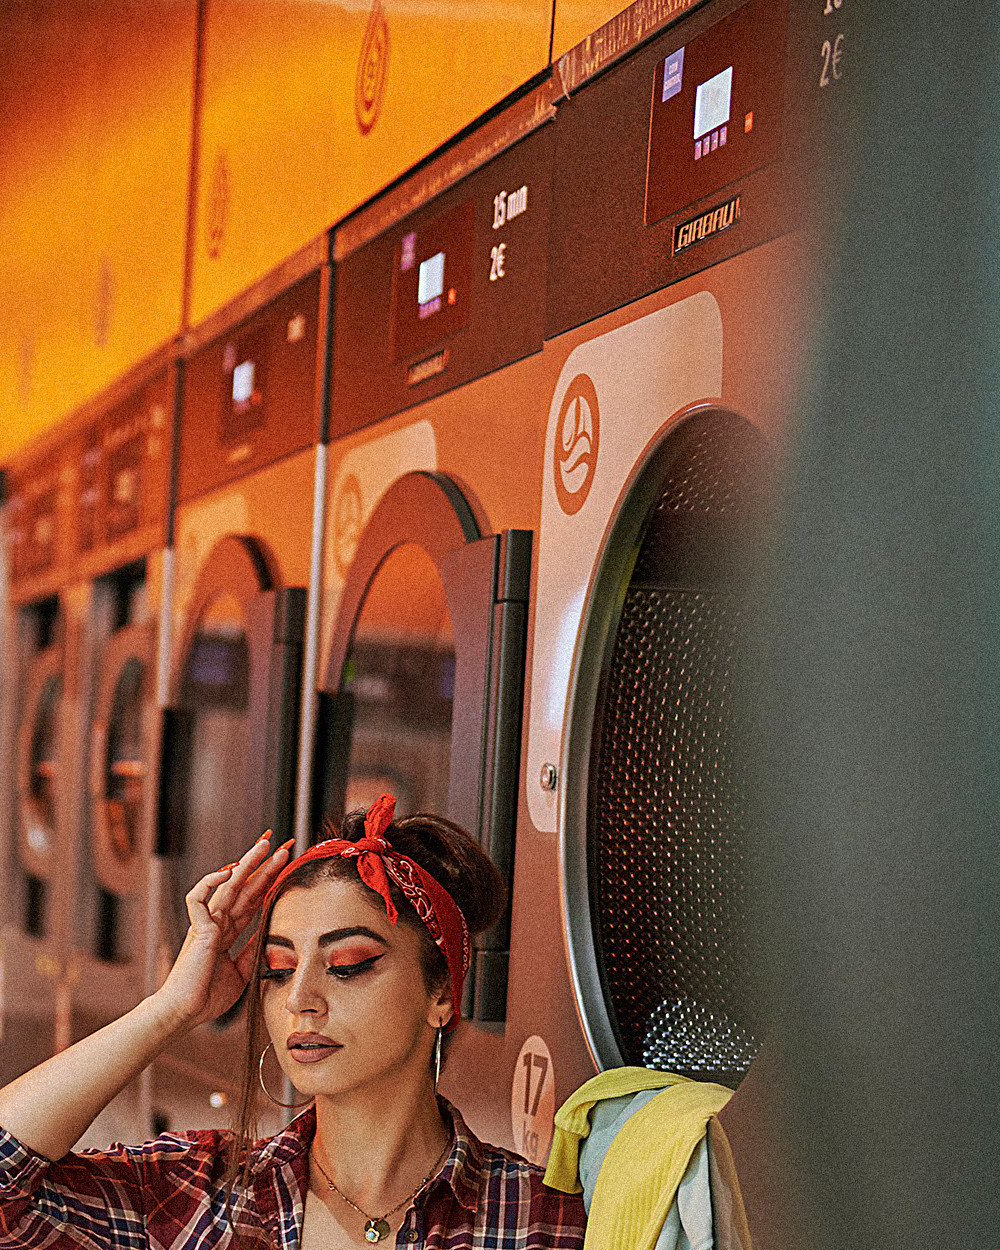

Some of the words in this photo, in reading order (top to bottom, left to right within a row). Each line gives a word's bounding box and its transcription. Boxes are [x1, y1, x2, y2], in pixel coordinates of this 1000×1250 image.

[820, 34, 844, 87] 2€
[492, 190, 507, 230] 15
[678, 200, 735, 248] GIRBAU
[489, 243, 507, 281] 2€
[523, 1052, 549, 1117] 17
